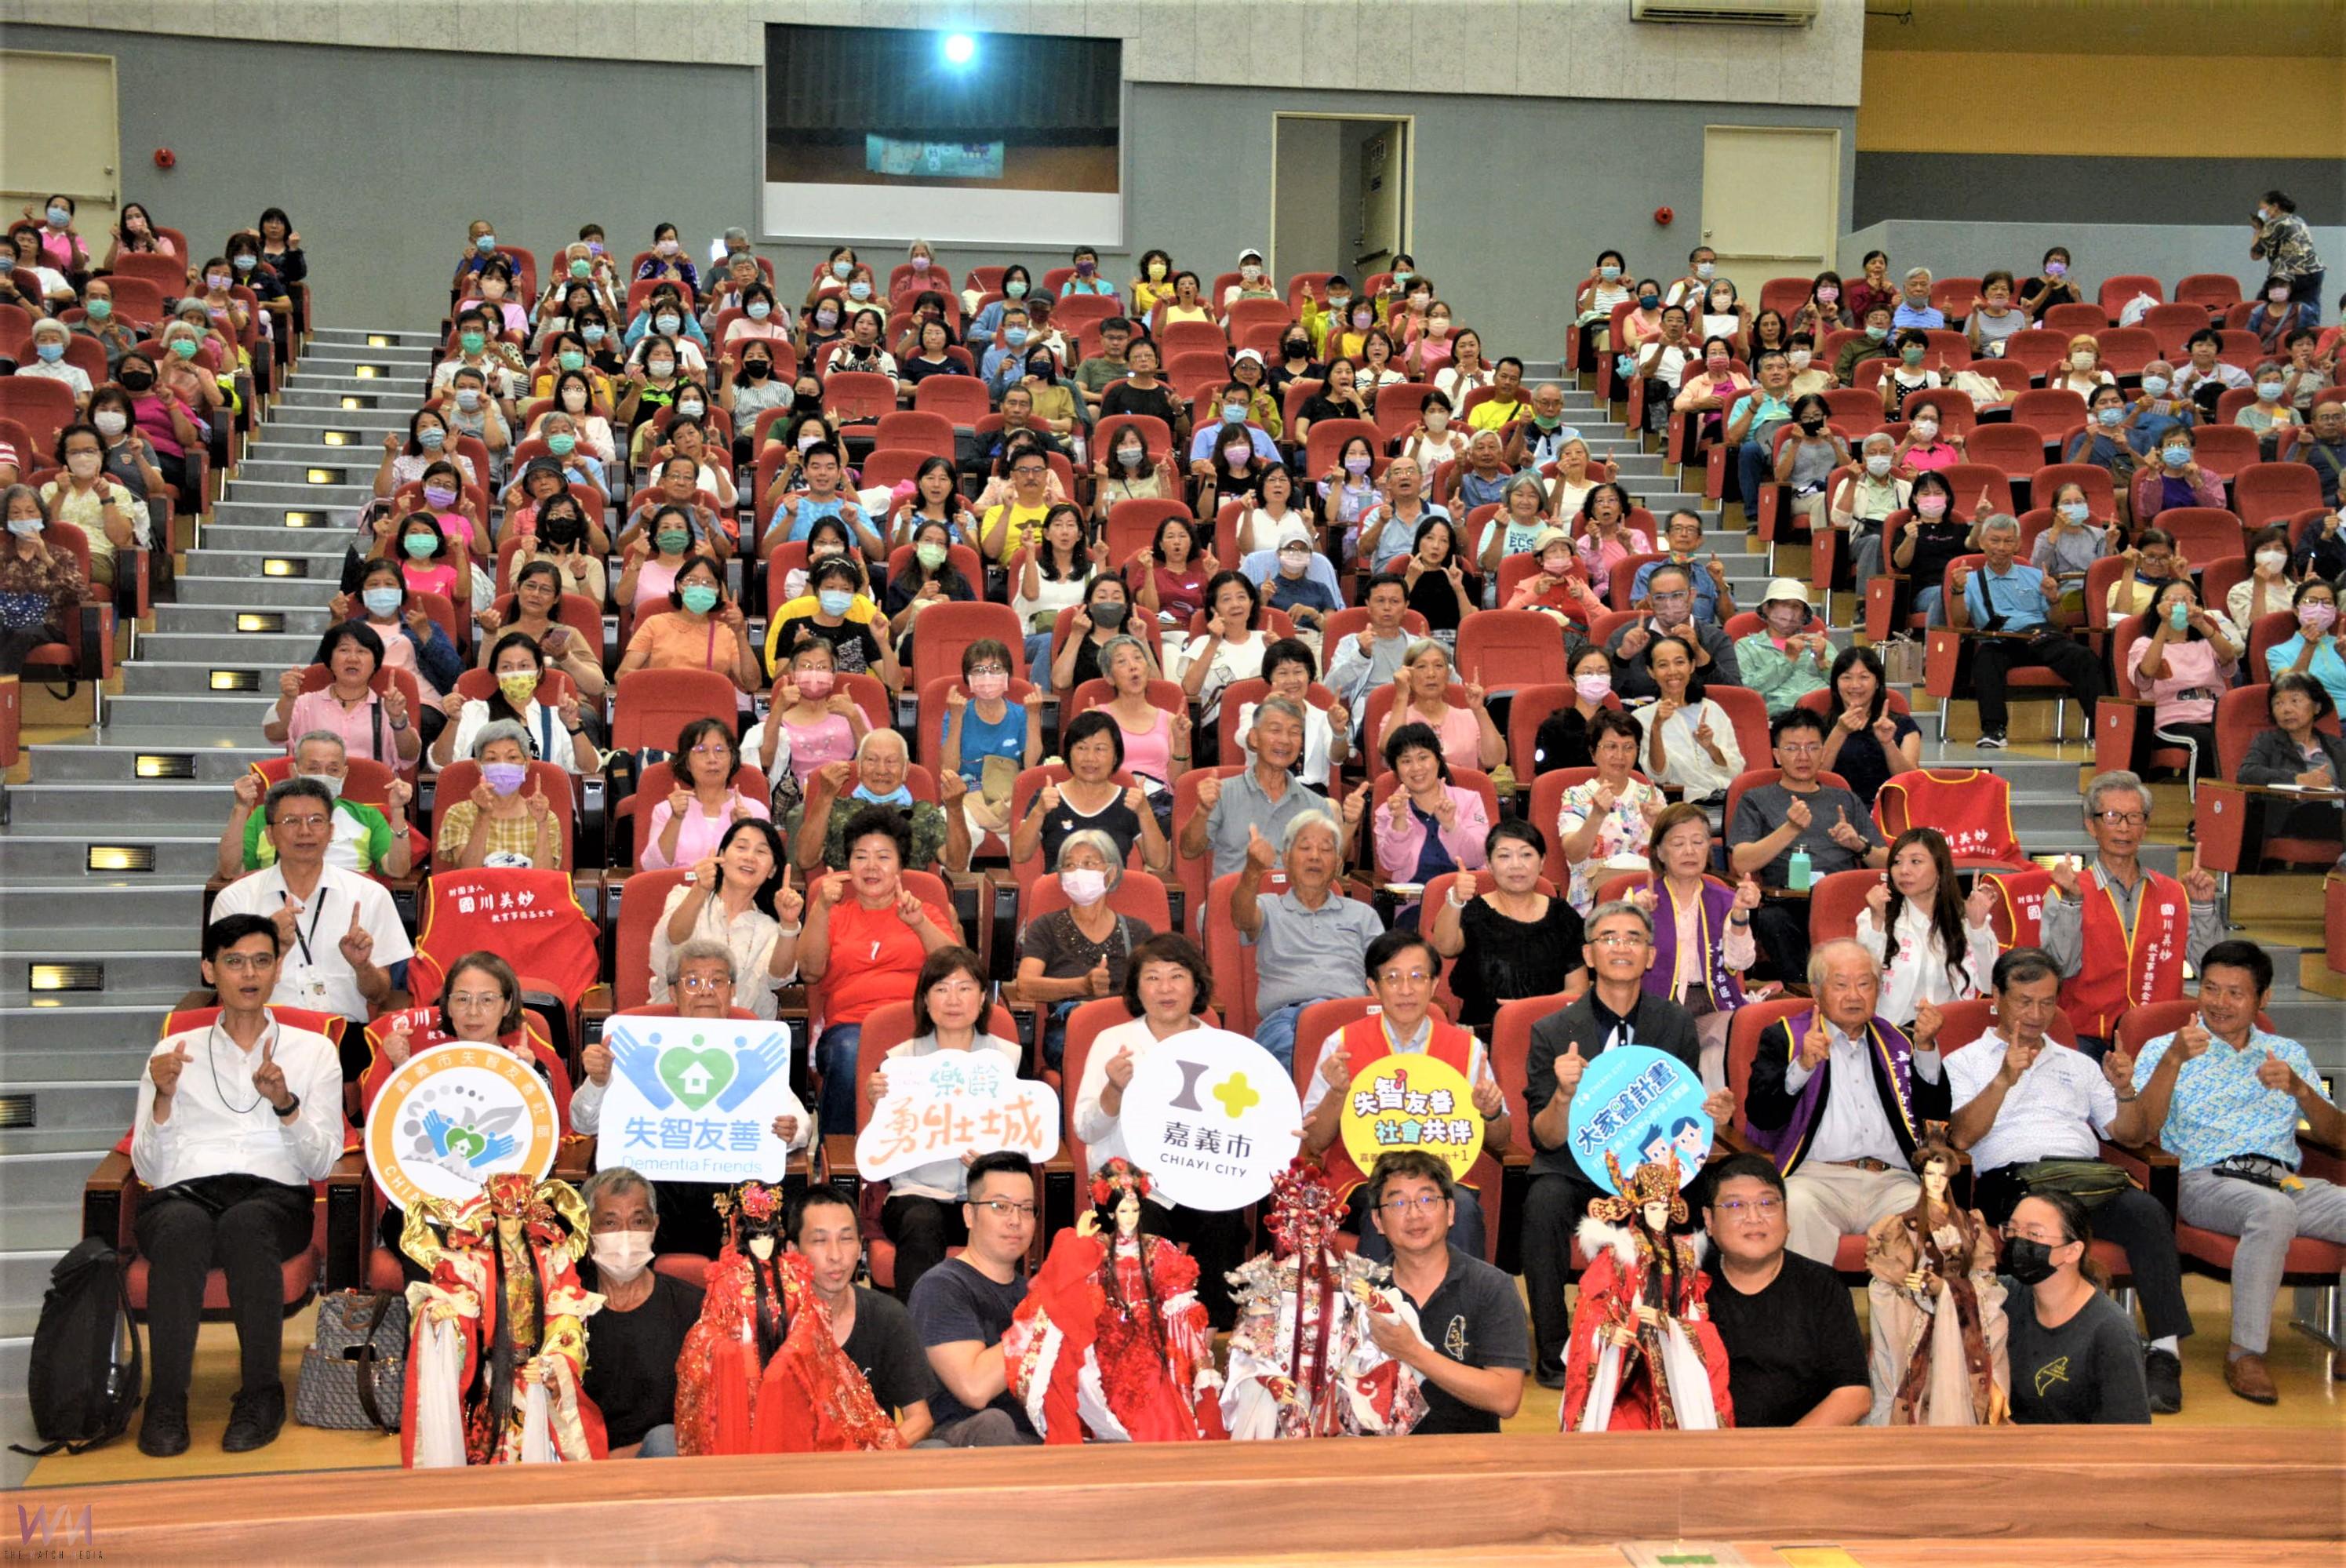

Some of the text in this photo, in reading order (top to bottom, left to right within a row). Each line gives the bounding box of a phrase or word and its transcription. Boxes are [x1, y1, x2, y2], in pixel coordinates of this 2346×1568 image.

[449, 884, 485, 897] 財團法人
[624, 1116, 762, 1151] 失智友善
[1163, 1121, 1254, 1159] 嘉義市
[1374, 1119, 1474, 1145] 社會共伴
[621, 1155, 762, 1173] Dementia Friends
[1160, 1153, 1248, 1178] CHIAYI CITY
